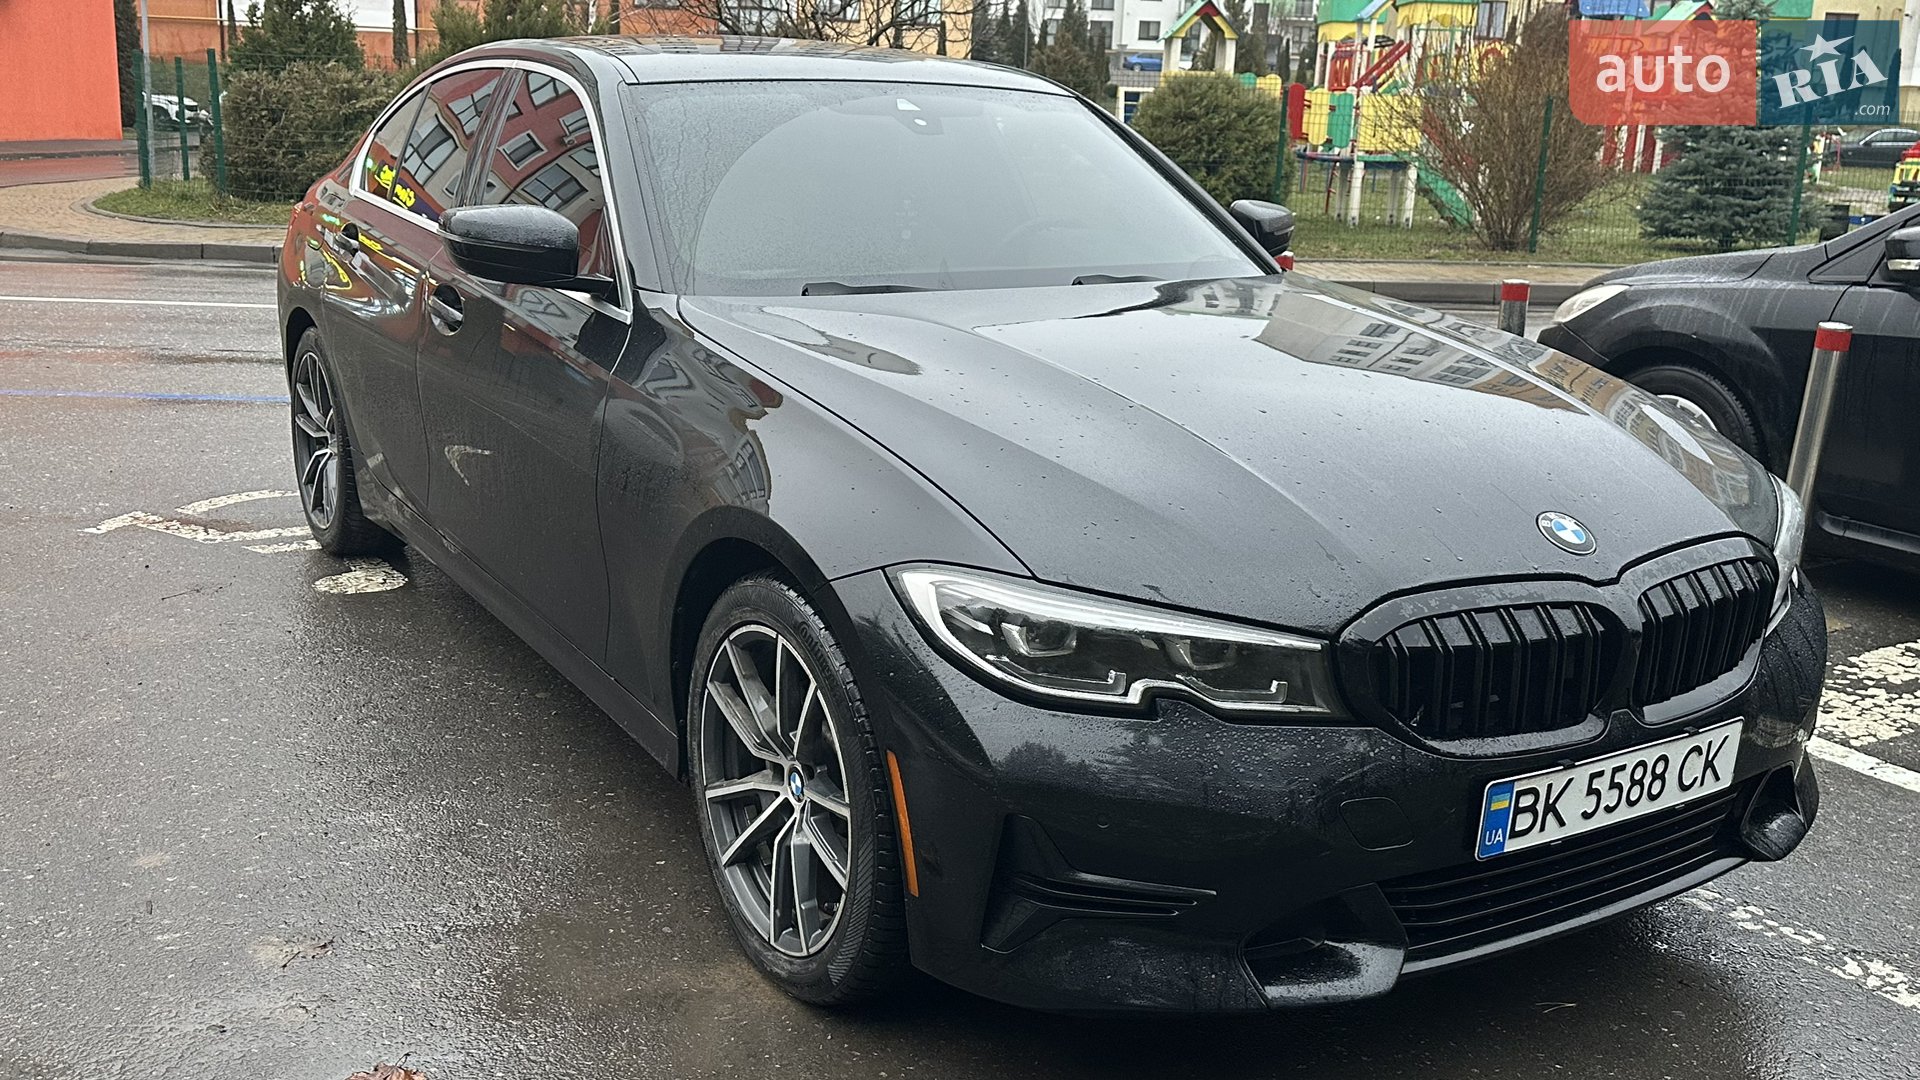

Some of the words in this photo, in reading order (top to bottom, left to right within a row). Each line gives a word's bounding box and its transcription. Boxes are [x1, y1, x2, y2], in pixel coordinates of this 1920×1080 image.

[1508, 776, 1575, 840] BK
[1580, 753, 1669, 820] 5588
[1677, 734, 1730, 792] CK
[1484, 827, 1504, 846] UA
